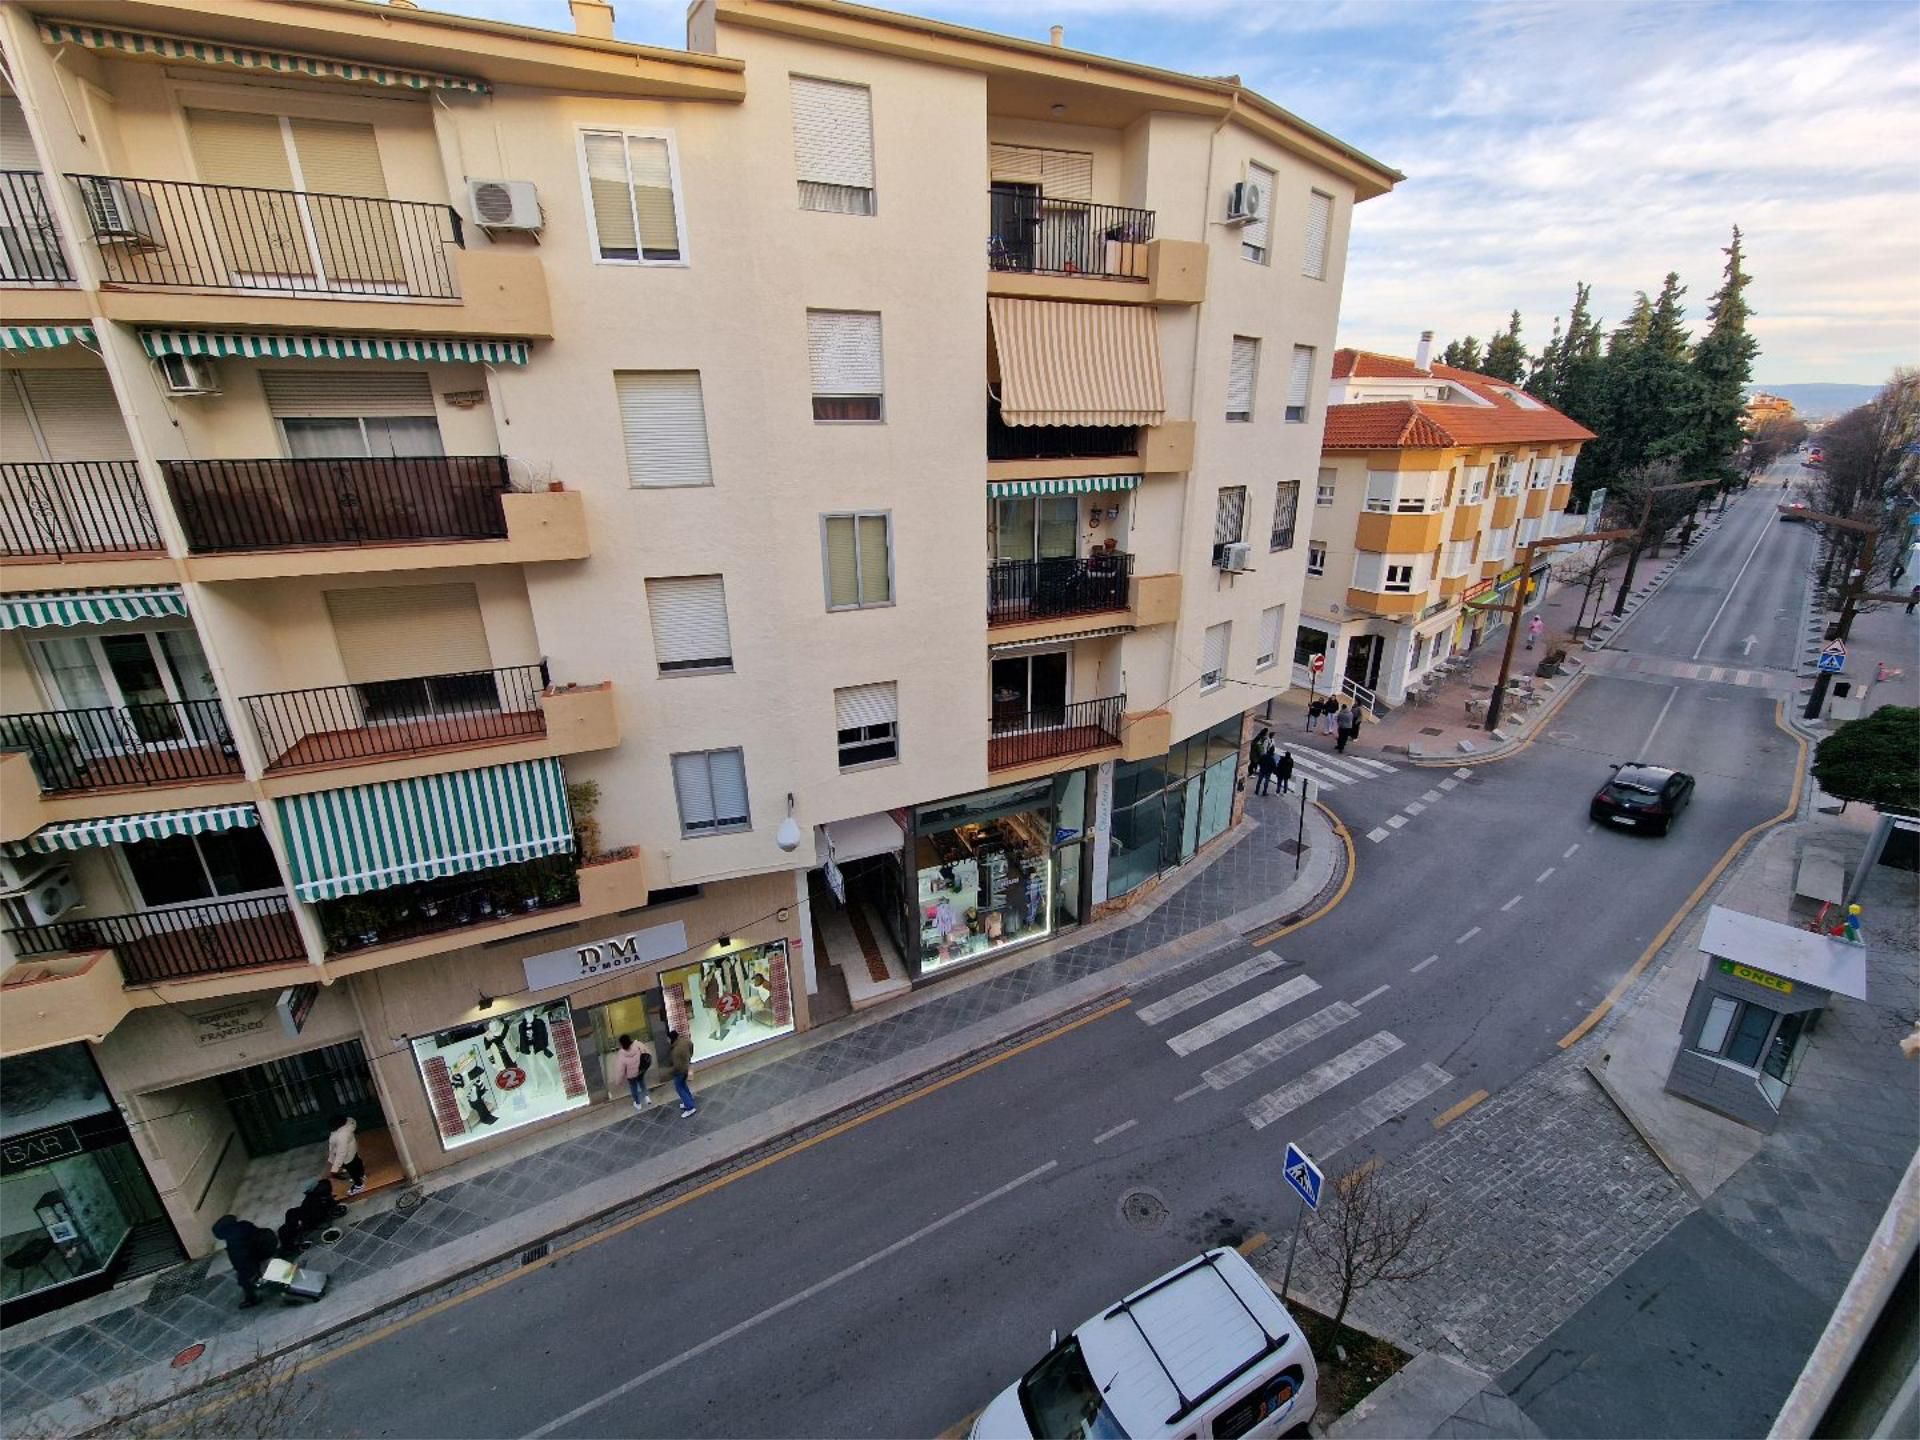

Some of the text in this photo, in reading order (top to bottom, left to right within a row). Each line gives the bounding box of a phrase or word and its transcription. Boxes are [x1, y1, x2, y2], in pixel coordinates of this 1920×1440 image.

[1740, 968, 1787, 989] ONCE
[198, 1007, 249, 1025] EDIFICIO
[200, 1021, 264, 1042] FRANCISCO
[501, 1071, 520, 1088] 2
[4, 1136, 63, 1164] BAR
